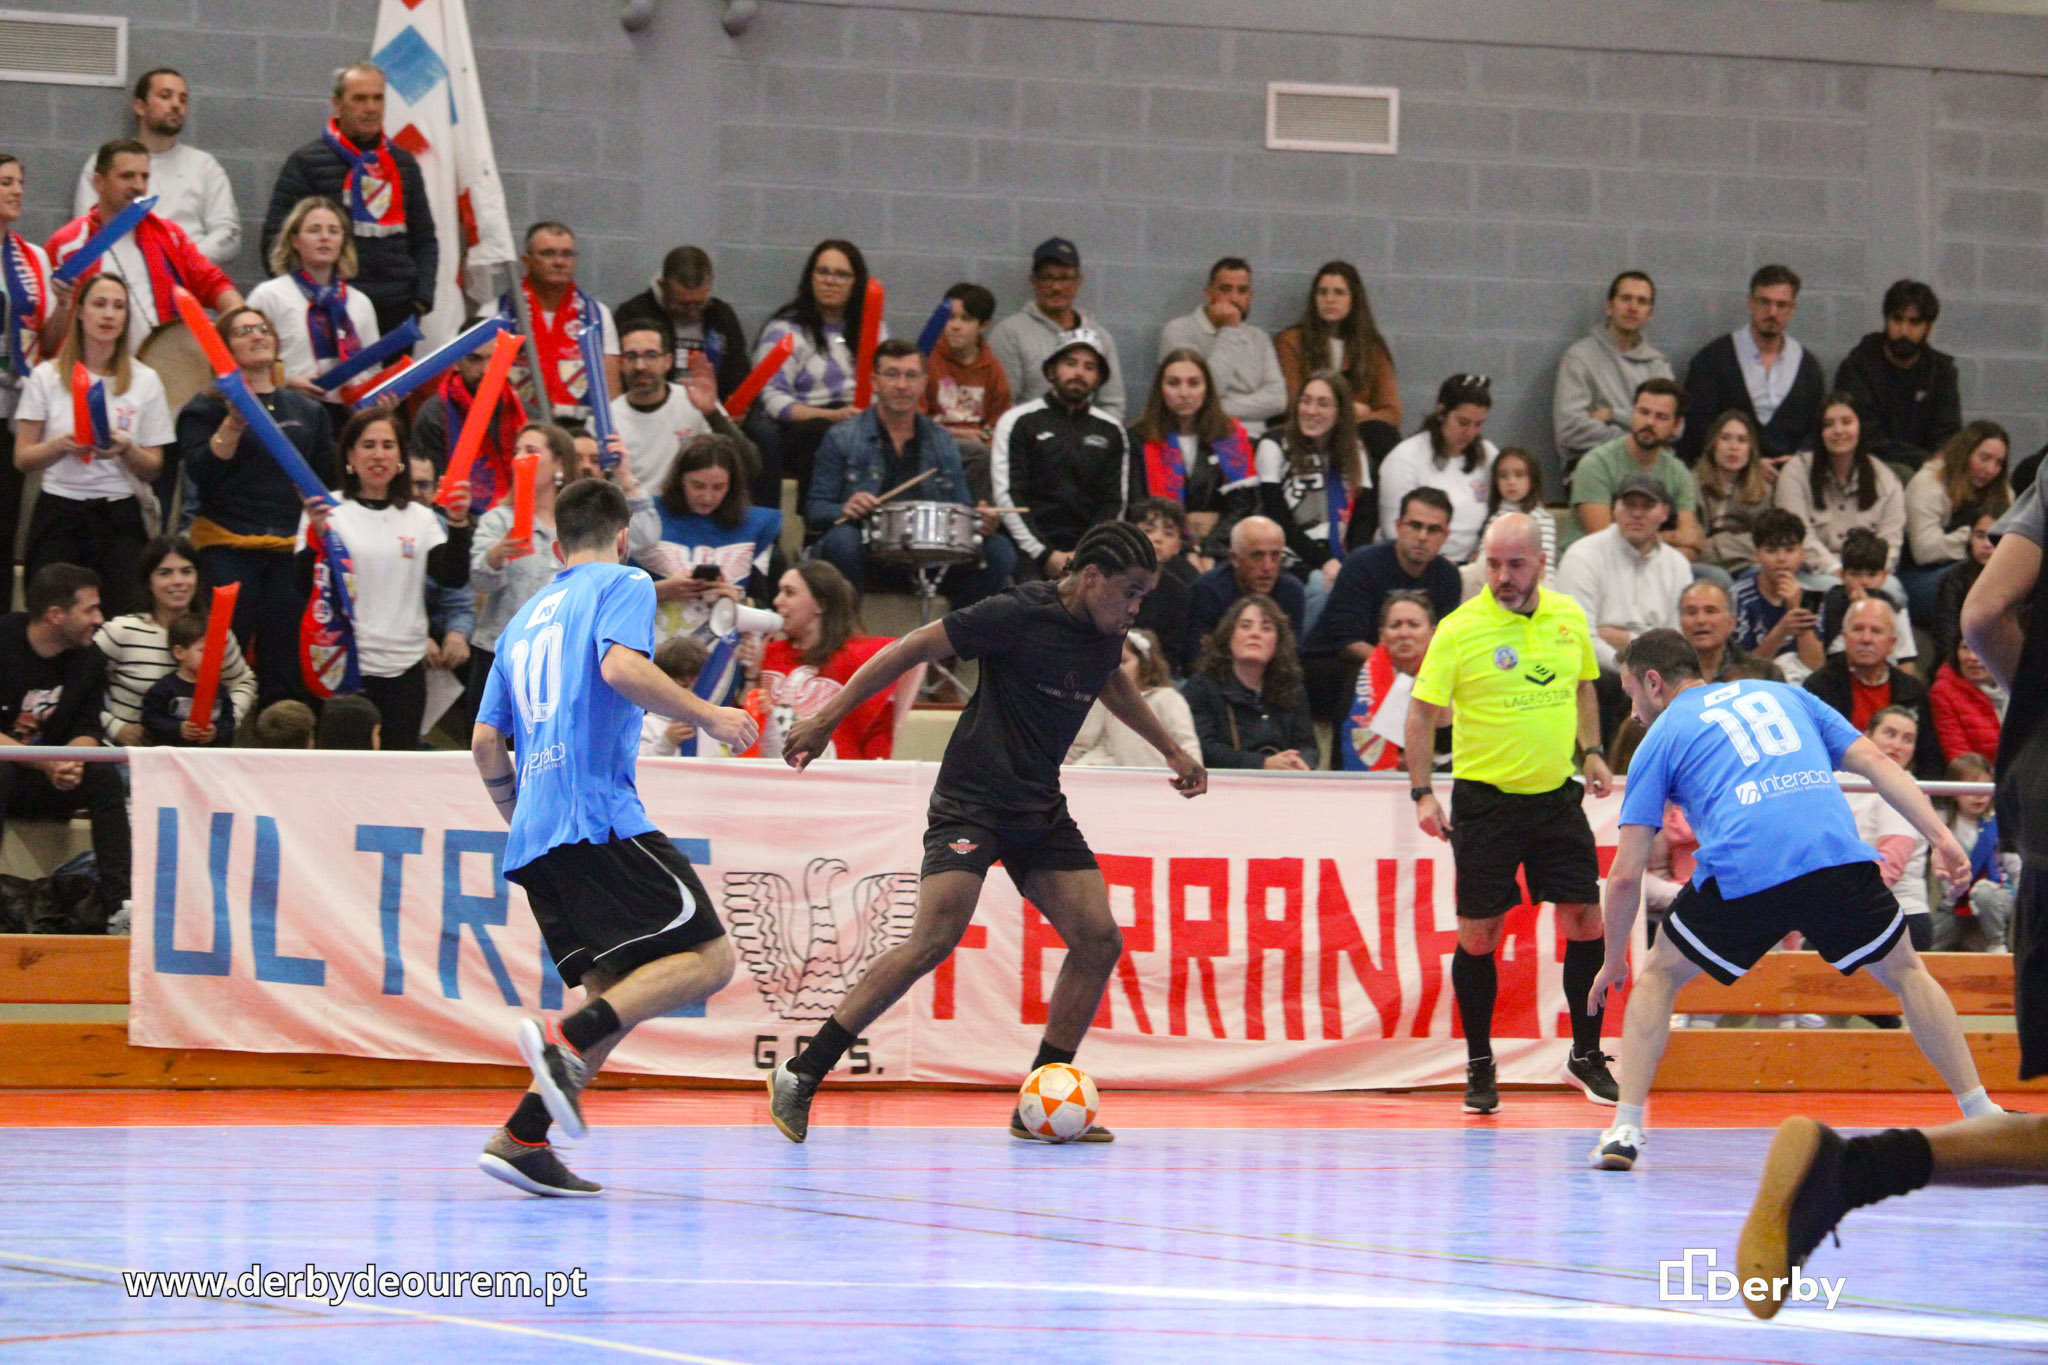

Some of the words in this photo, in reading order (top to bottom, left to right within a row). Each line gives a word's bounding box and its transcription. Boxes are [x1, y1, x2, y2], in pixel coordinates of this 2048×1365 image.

[511, 622, 563, 734] 10
[1699, 691, 1801, 767] 18
[1759, 770, 1831, 794] interaco
[153, 806, 711, 1018] ULTR
